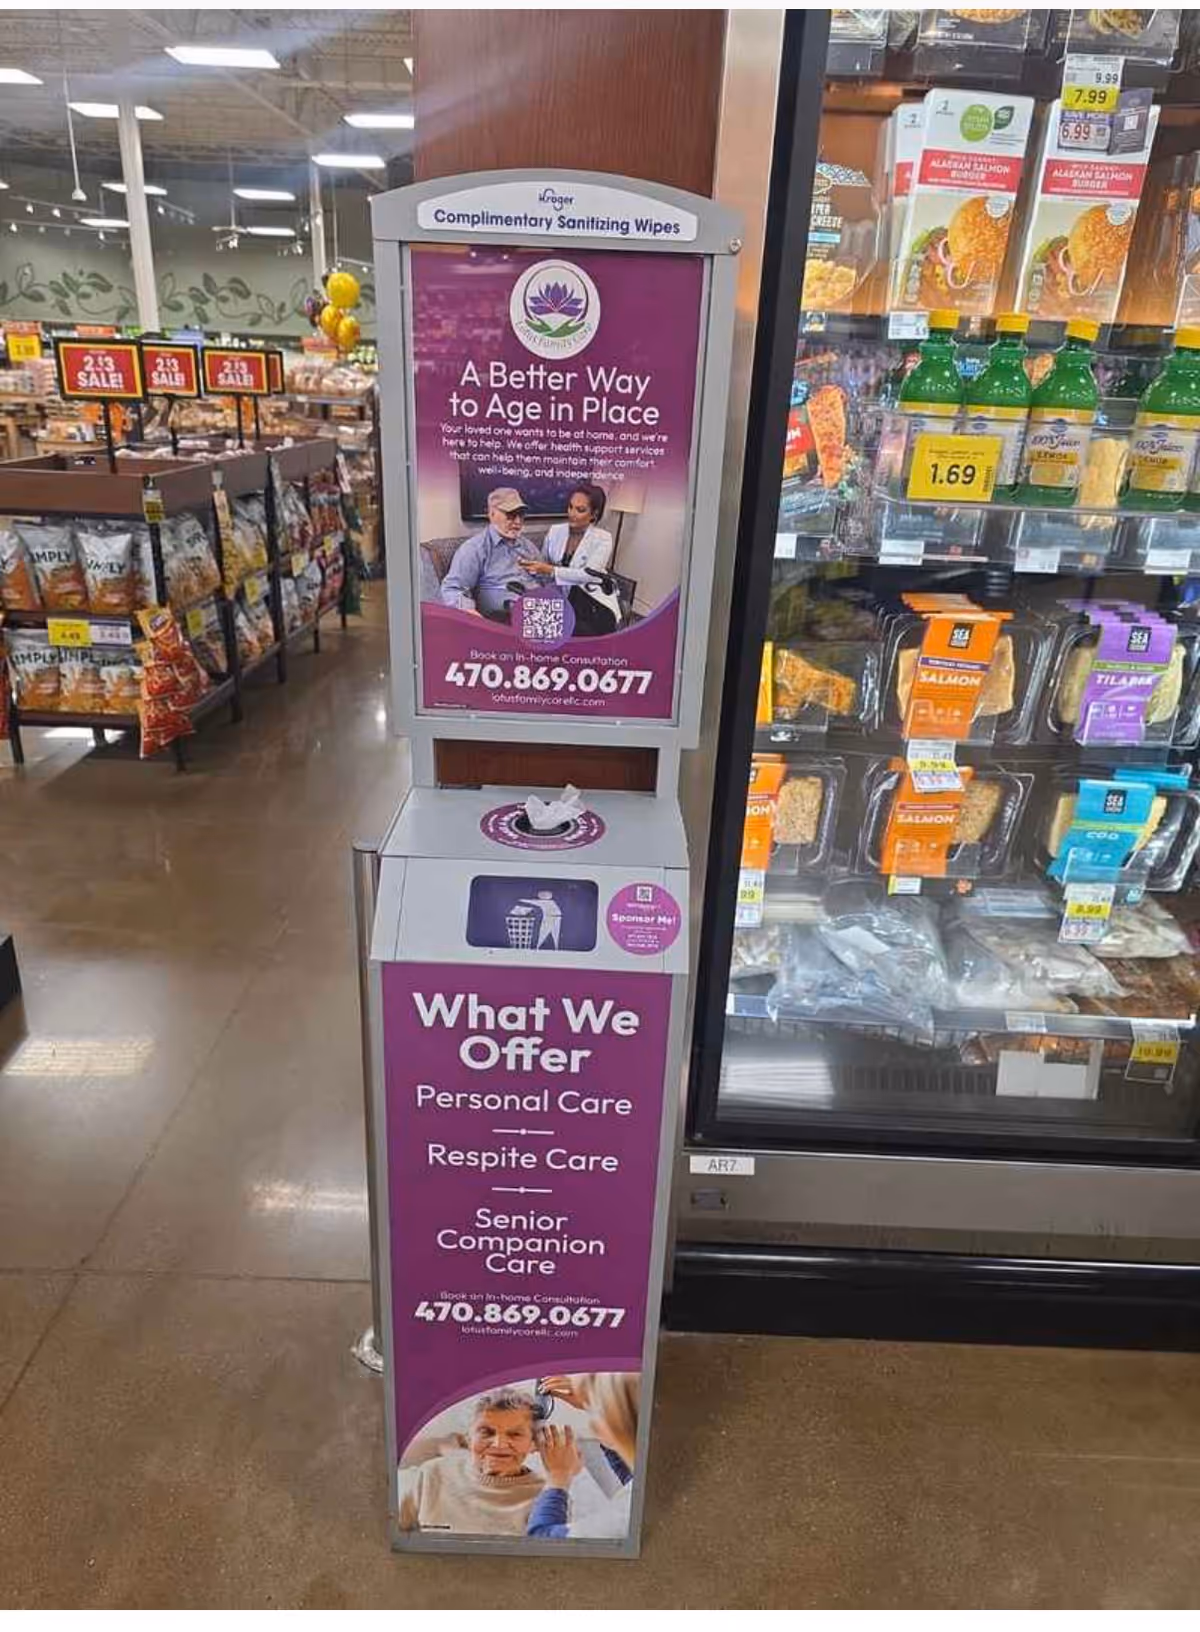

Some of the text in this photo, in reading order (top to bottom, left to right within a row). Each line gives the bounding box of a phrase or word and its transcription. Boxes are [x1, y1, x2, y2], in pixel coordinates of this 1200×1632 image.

[1073, 89, 1108, 104] 7.99
[1061, 123, 1091, 140] 6.99
[929, 159, 1010, 174] ALASKAN SALMON
[949, 170, 986, 180] BURGER
[1052, 169, 1133, 182] ALASKAN SALMON
[1071, 179, 1108, 190] BURGER
[538, 188, 575, 211] Kroger
[434, 209, 681, 235] Complimentary Sanitizing Wipes
[77, 371, 124, 388] SALE!
[151, 371, 185, 386] SALE!
[217, 373, 254, 386] SALE!
[460, 360, 651, 400] A Better Way
[449, 391, 660, 426] to Age in Place
[440, 423, 668, 443] Your loved one wants to be at home, and we're
[442, 437, 665, 456] here to help. We offer health support services
[449, 451, 470, 461] that
[472, 453, 490, 462] can
[492, 452, 514, 464] help
[516, 453, 541, 463] them
[543, 455, 587, 466] maintain
[589, 456, 612, 467] their
[478, 466, 533, 479] well-being,
[534, 468, 554, 478] and
[931, 463, 976, 485] 1.69
[953, 628, 971, 640] SEA
[1131, 631, 1149, 644] SEA
[470, 650, 628, 666] Book an In-home Consultation
[444, 662, 653, 695] 470.869.0677
[920, 670, 981, 686] SALMON
[1106, 794, 1123, 806] SEA
[897, 814, 955, 824] SALMON
[1085, 831, 1119, 841] COD
[611, 913, 676, 925] Sponsor Me!
[413, 992, 640, 1035] What We
[459, 1035, 592, 1073] Offer
[416, 1085, 632, 1115] Personal Care
[428, 1144, 619, 1172] Respite Care
[708, 1158, 737, 1172] AR7
[475, 1208, 568, 1231] Senior
[437, 1229, 605, 1255] Companion
[485, 1253, 556, 1274] Care
[440, 1291, 601, 1305] Book an In-home Consultation
[414, 1301, 625, 1328] 470.869.0677
